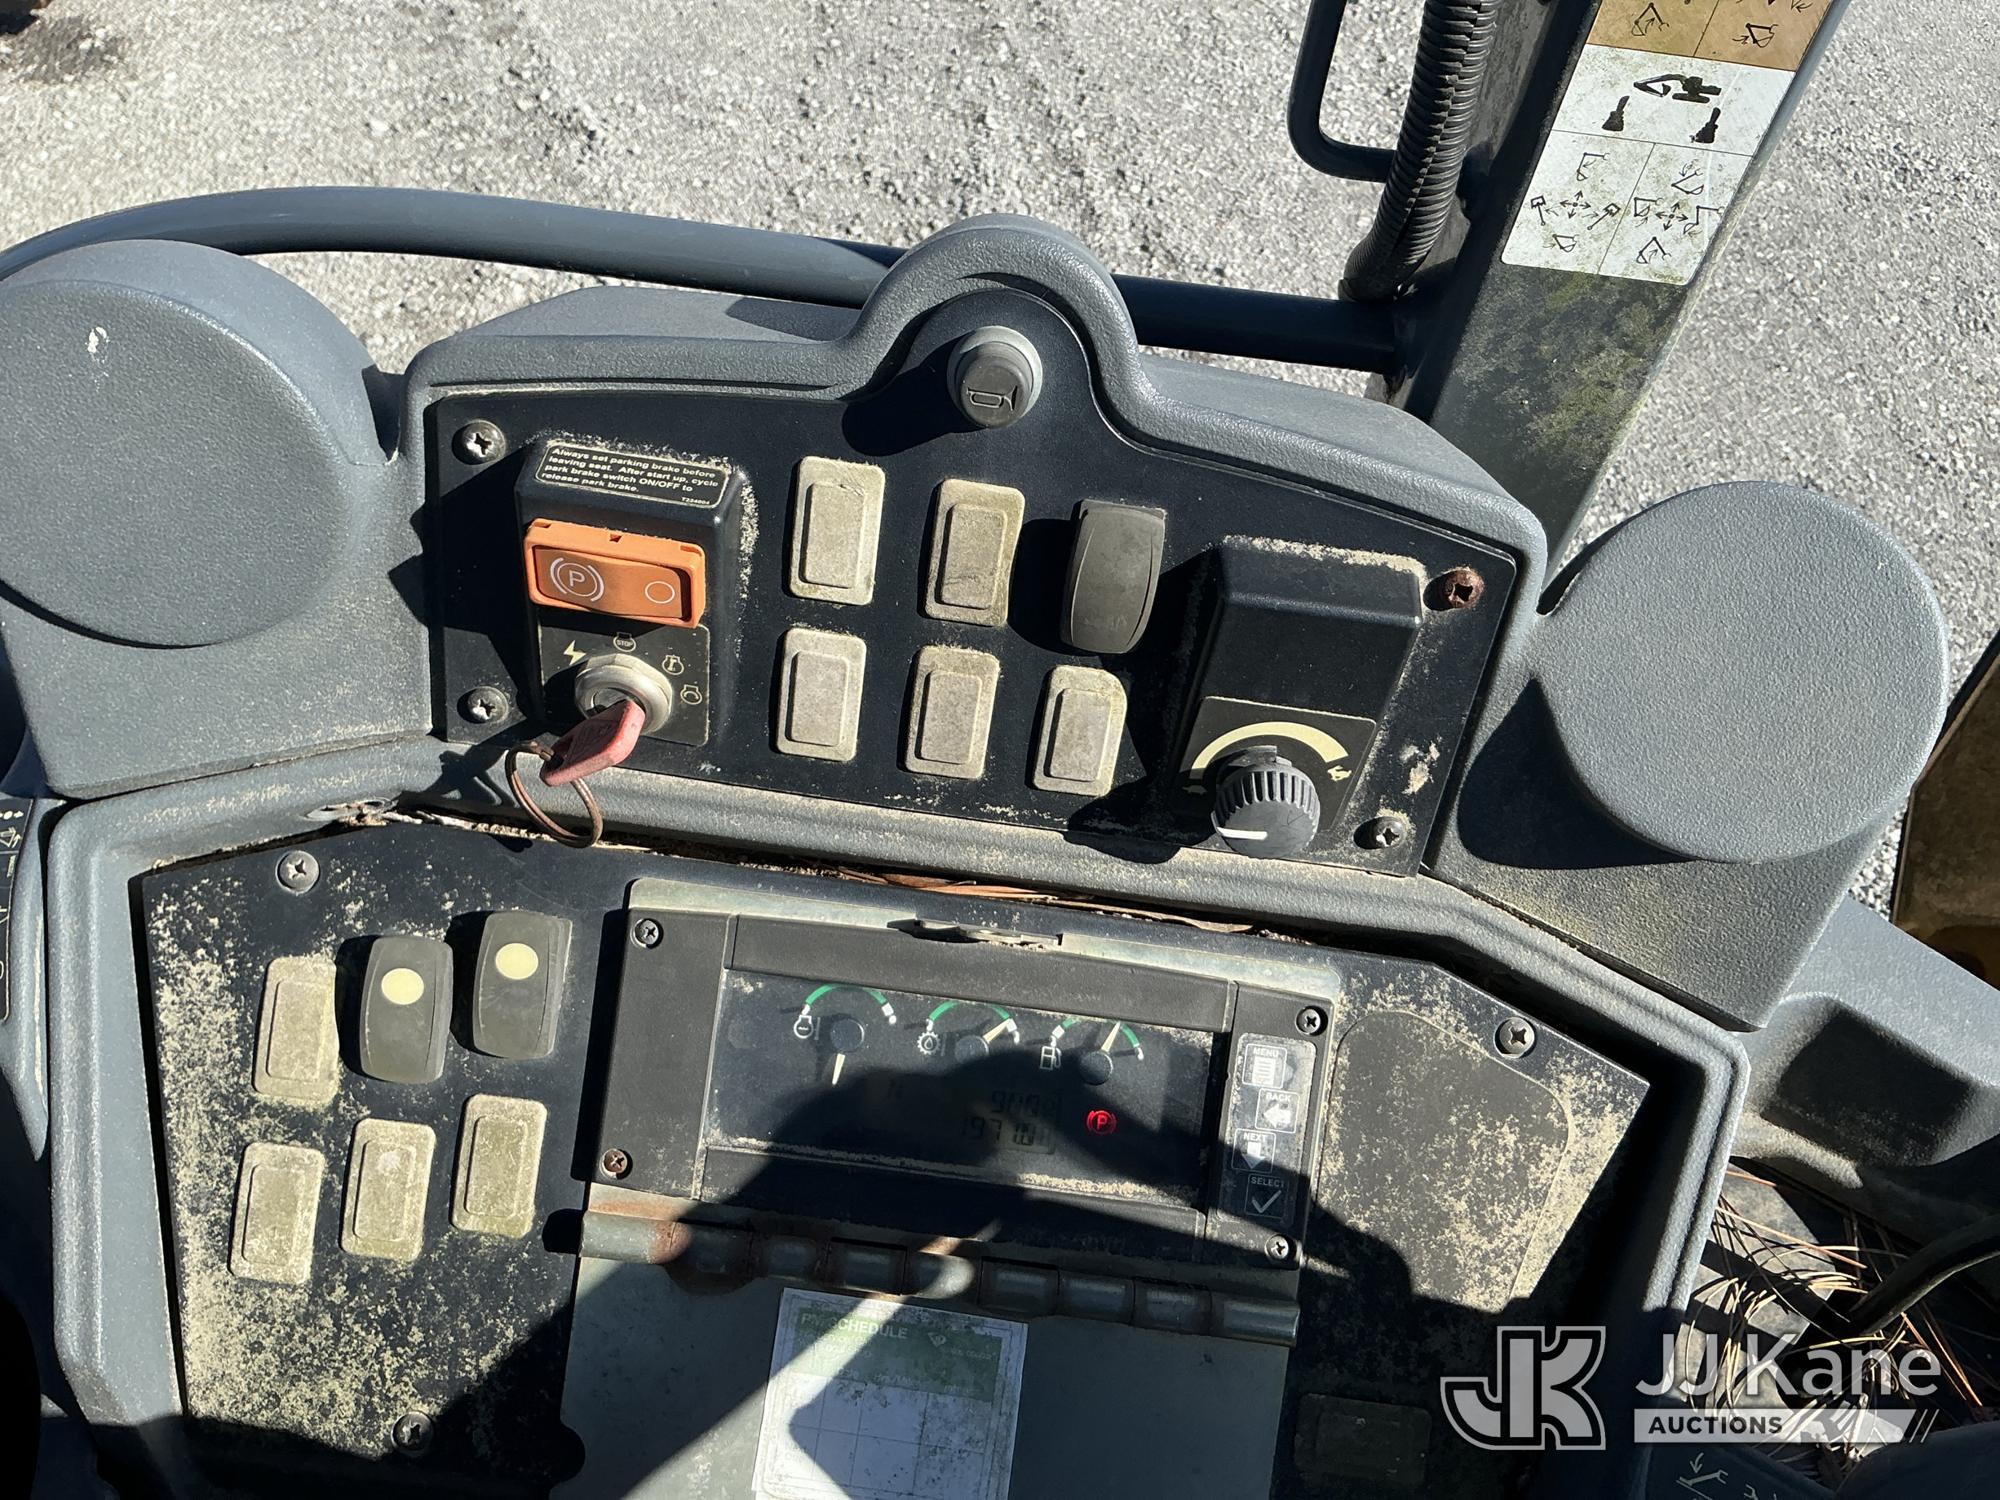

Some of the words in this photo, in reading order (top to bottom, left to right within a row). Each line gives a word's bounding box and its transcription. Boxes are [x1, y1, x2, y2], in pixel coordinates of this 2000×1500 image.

[552, 448, 590, 460] Always
[592, 454, 609, 462] set
[609, 456, 649, 470] parking
[651, 463, 680, 473] brake
[682, 467, 716, 479] before
[544, 464, 569, 473] park
[570, 467, 600, 478] brake
[602, 473, 636, 484] switch
[638, 477, 680, 490] ON/OFF
[682, 484, 693, 492] to
[548, 455, 587, 468] leaving
[588, 462, 613, 471] seat.
[618, 466, 646, 476] After
[646, 472, 671, 481] start
[691, 478, 719, 487] cycle
[541, 472, 580, 483] release
[581, 478, 606, 487] park
[607, 481, 640, 493] brake.
[569, 570, 586, 587] P
[616, 639, 633, 647] STOP
[1253, 1047, 1280, 1058] MENU
[1265, 1092, 1291, 1102] BACK
[1243, 1132, 1268, 1143] NEXT
[1250, 1176, 1285, 1188] SELECT
